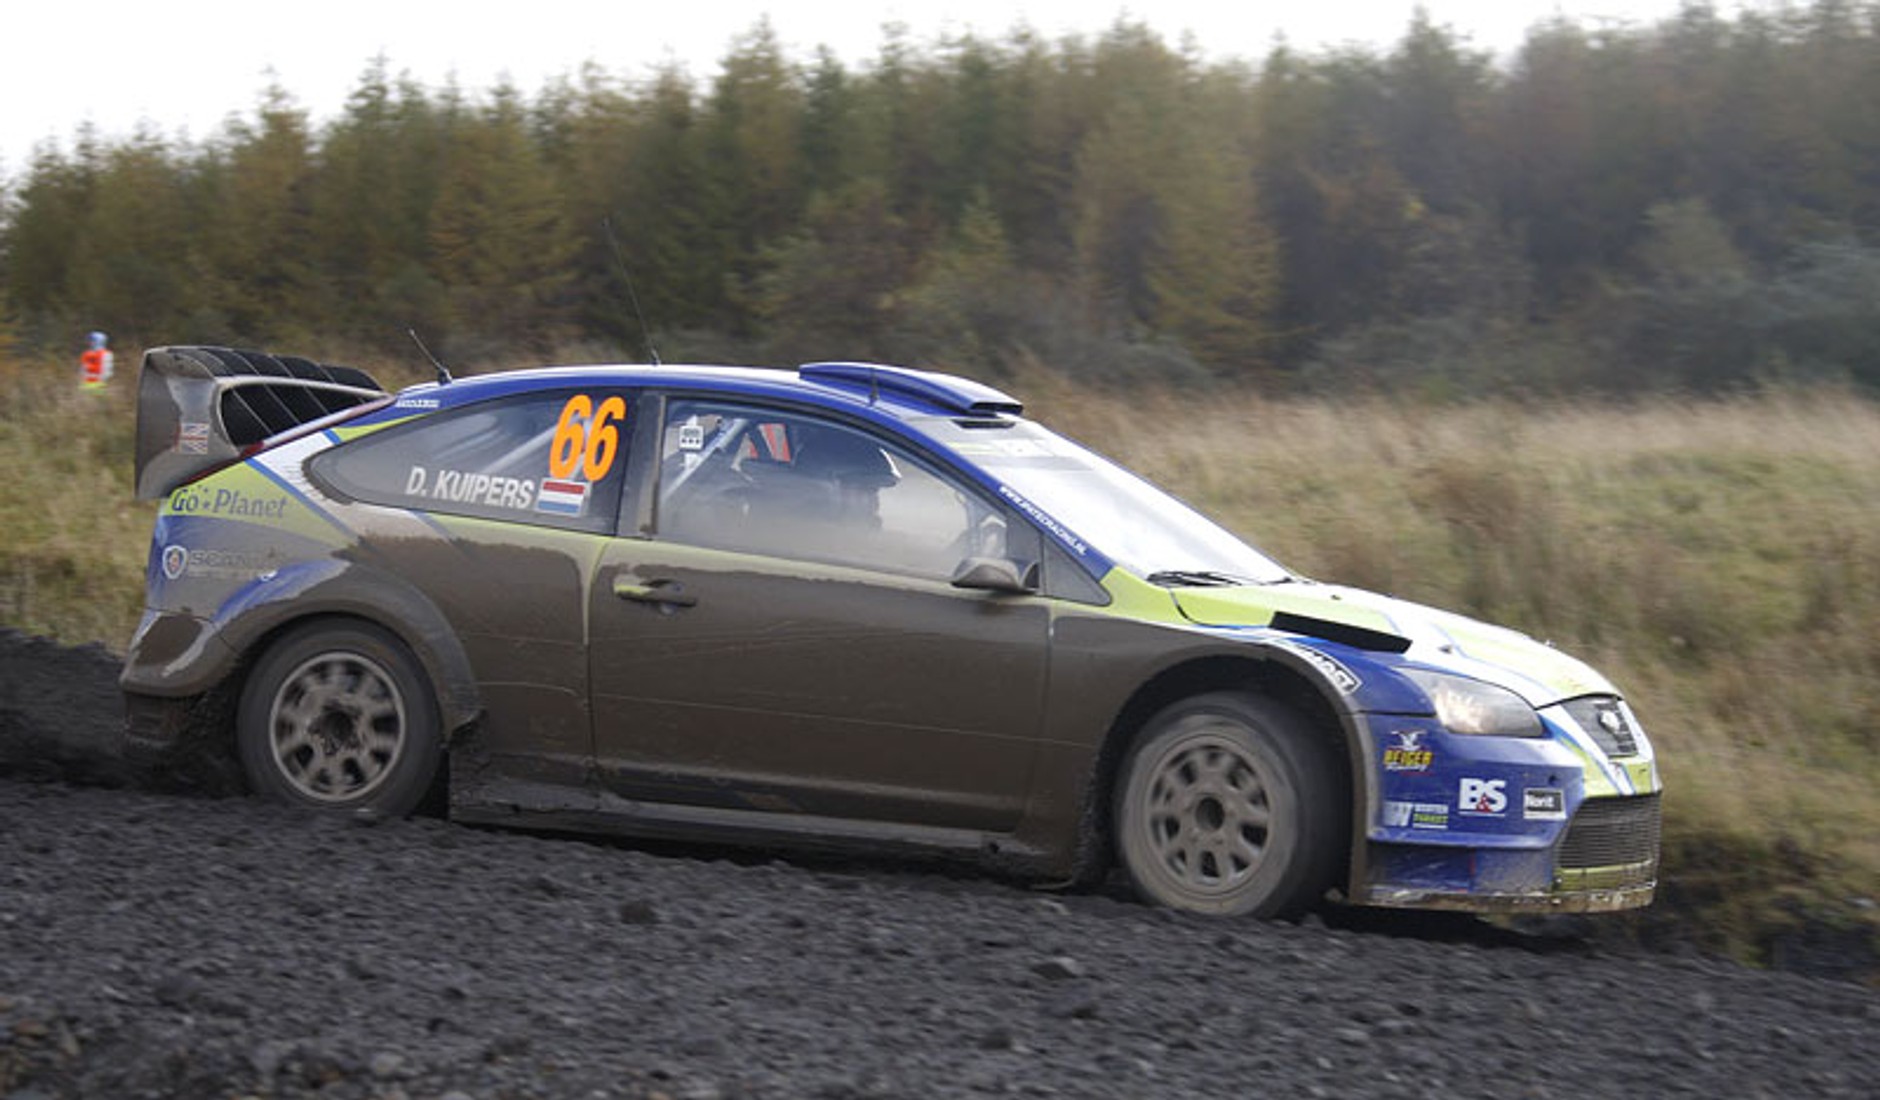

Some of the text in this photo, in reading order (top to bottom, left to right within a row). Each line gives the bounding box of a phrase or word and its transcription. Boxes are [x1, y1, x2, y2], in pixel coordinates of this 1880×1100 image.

[549, 394, 626, 482] 66
[212, 488, 287, 518] Planet
[405, 465, 535, 509] D. KUIPERS
[1458, 777, 1507, 814] B&S
